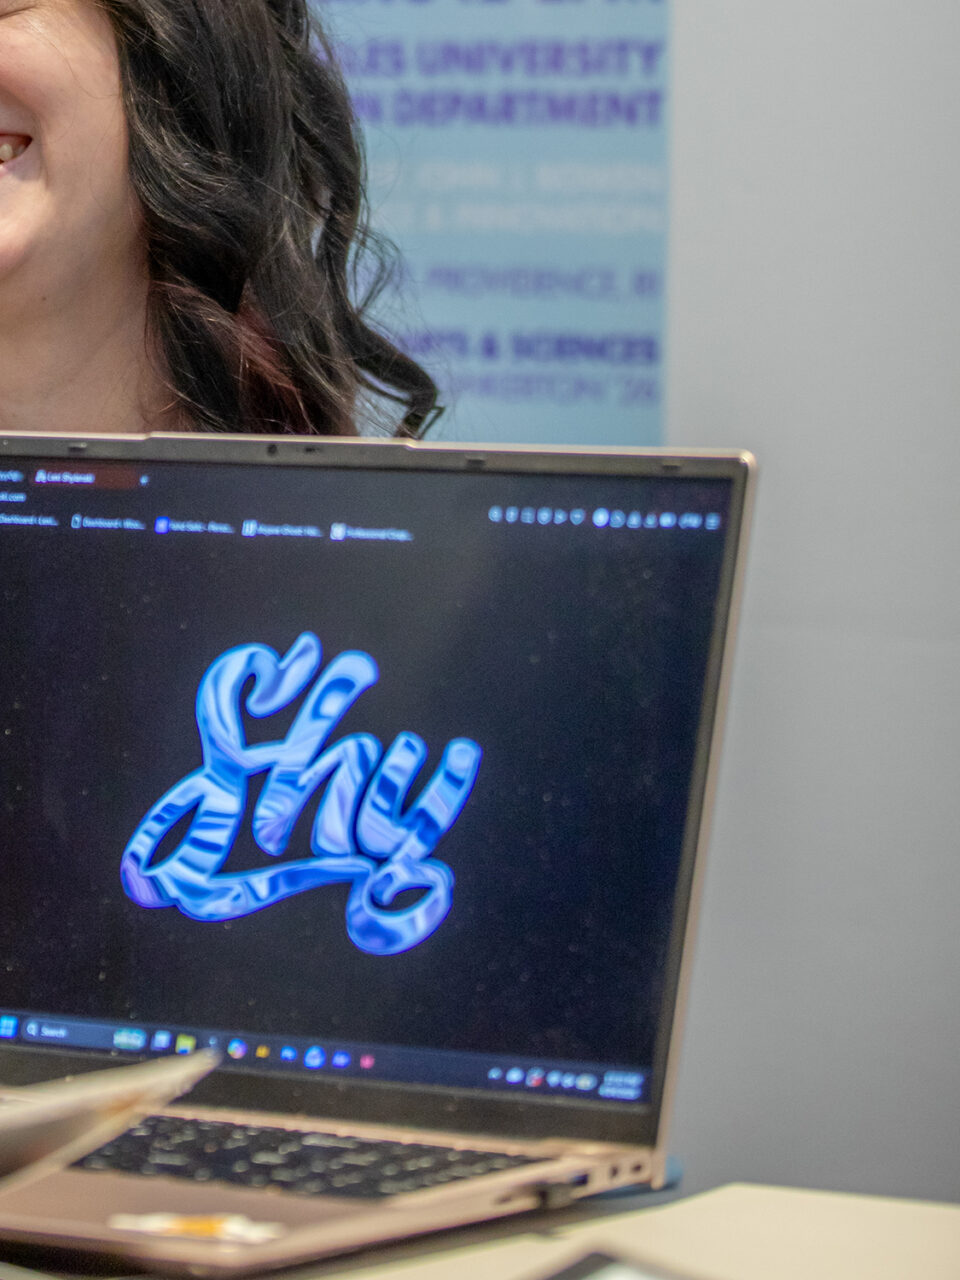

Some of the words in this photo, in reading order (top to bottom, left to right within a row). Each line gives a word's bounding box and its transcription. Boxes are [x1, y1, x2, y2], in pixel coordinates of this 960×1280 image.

[417, 38, 663, 77] UNIVERSITY
[393, 90, 662, 126] DEPARTMENT
[41, 1025, 67, 1038] Search
